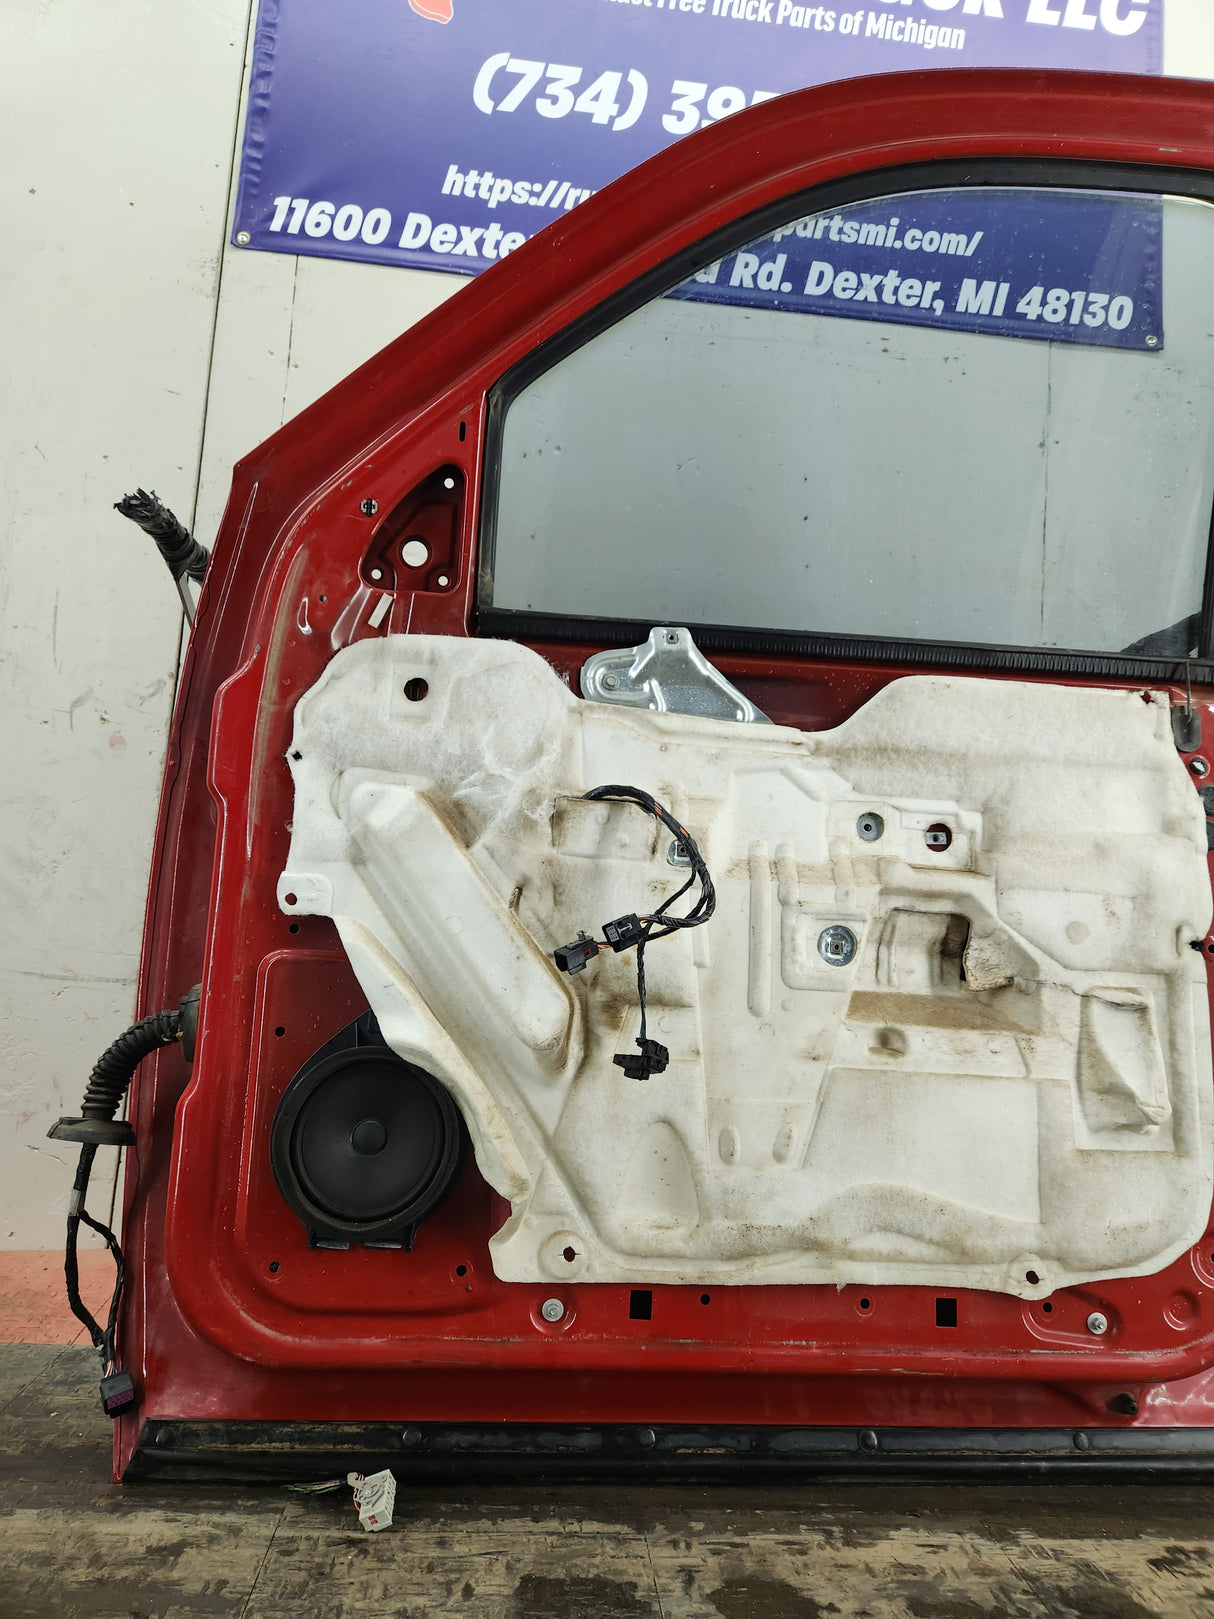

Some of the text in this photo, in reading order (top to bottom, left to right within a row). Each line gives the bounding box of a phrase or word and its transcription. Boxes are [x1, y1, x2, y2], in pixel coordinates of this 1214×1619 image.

[776, 0, 837, 32] Parts
[838, 10, 865, 35] of
[864, 11, 966, 50] Michigan
[472, 52, 783, 135] (734) 39
[268, 196, 392, 245] 11600
[398, 212, 534, 260] Dexte
[729, 252, 793, 293] Rd.
[803, 260, 945, 316] Dexter,
[955, 278, 1011, 317] MI
[1015, 285, 1135, 331] 48130
